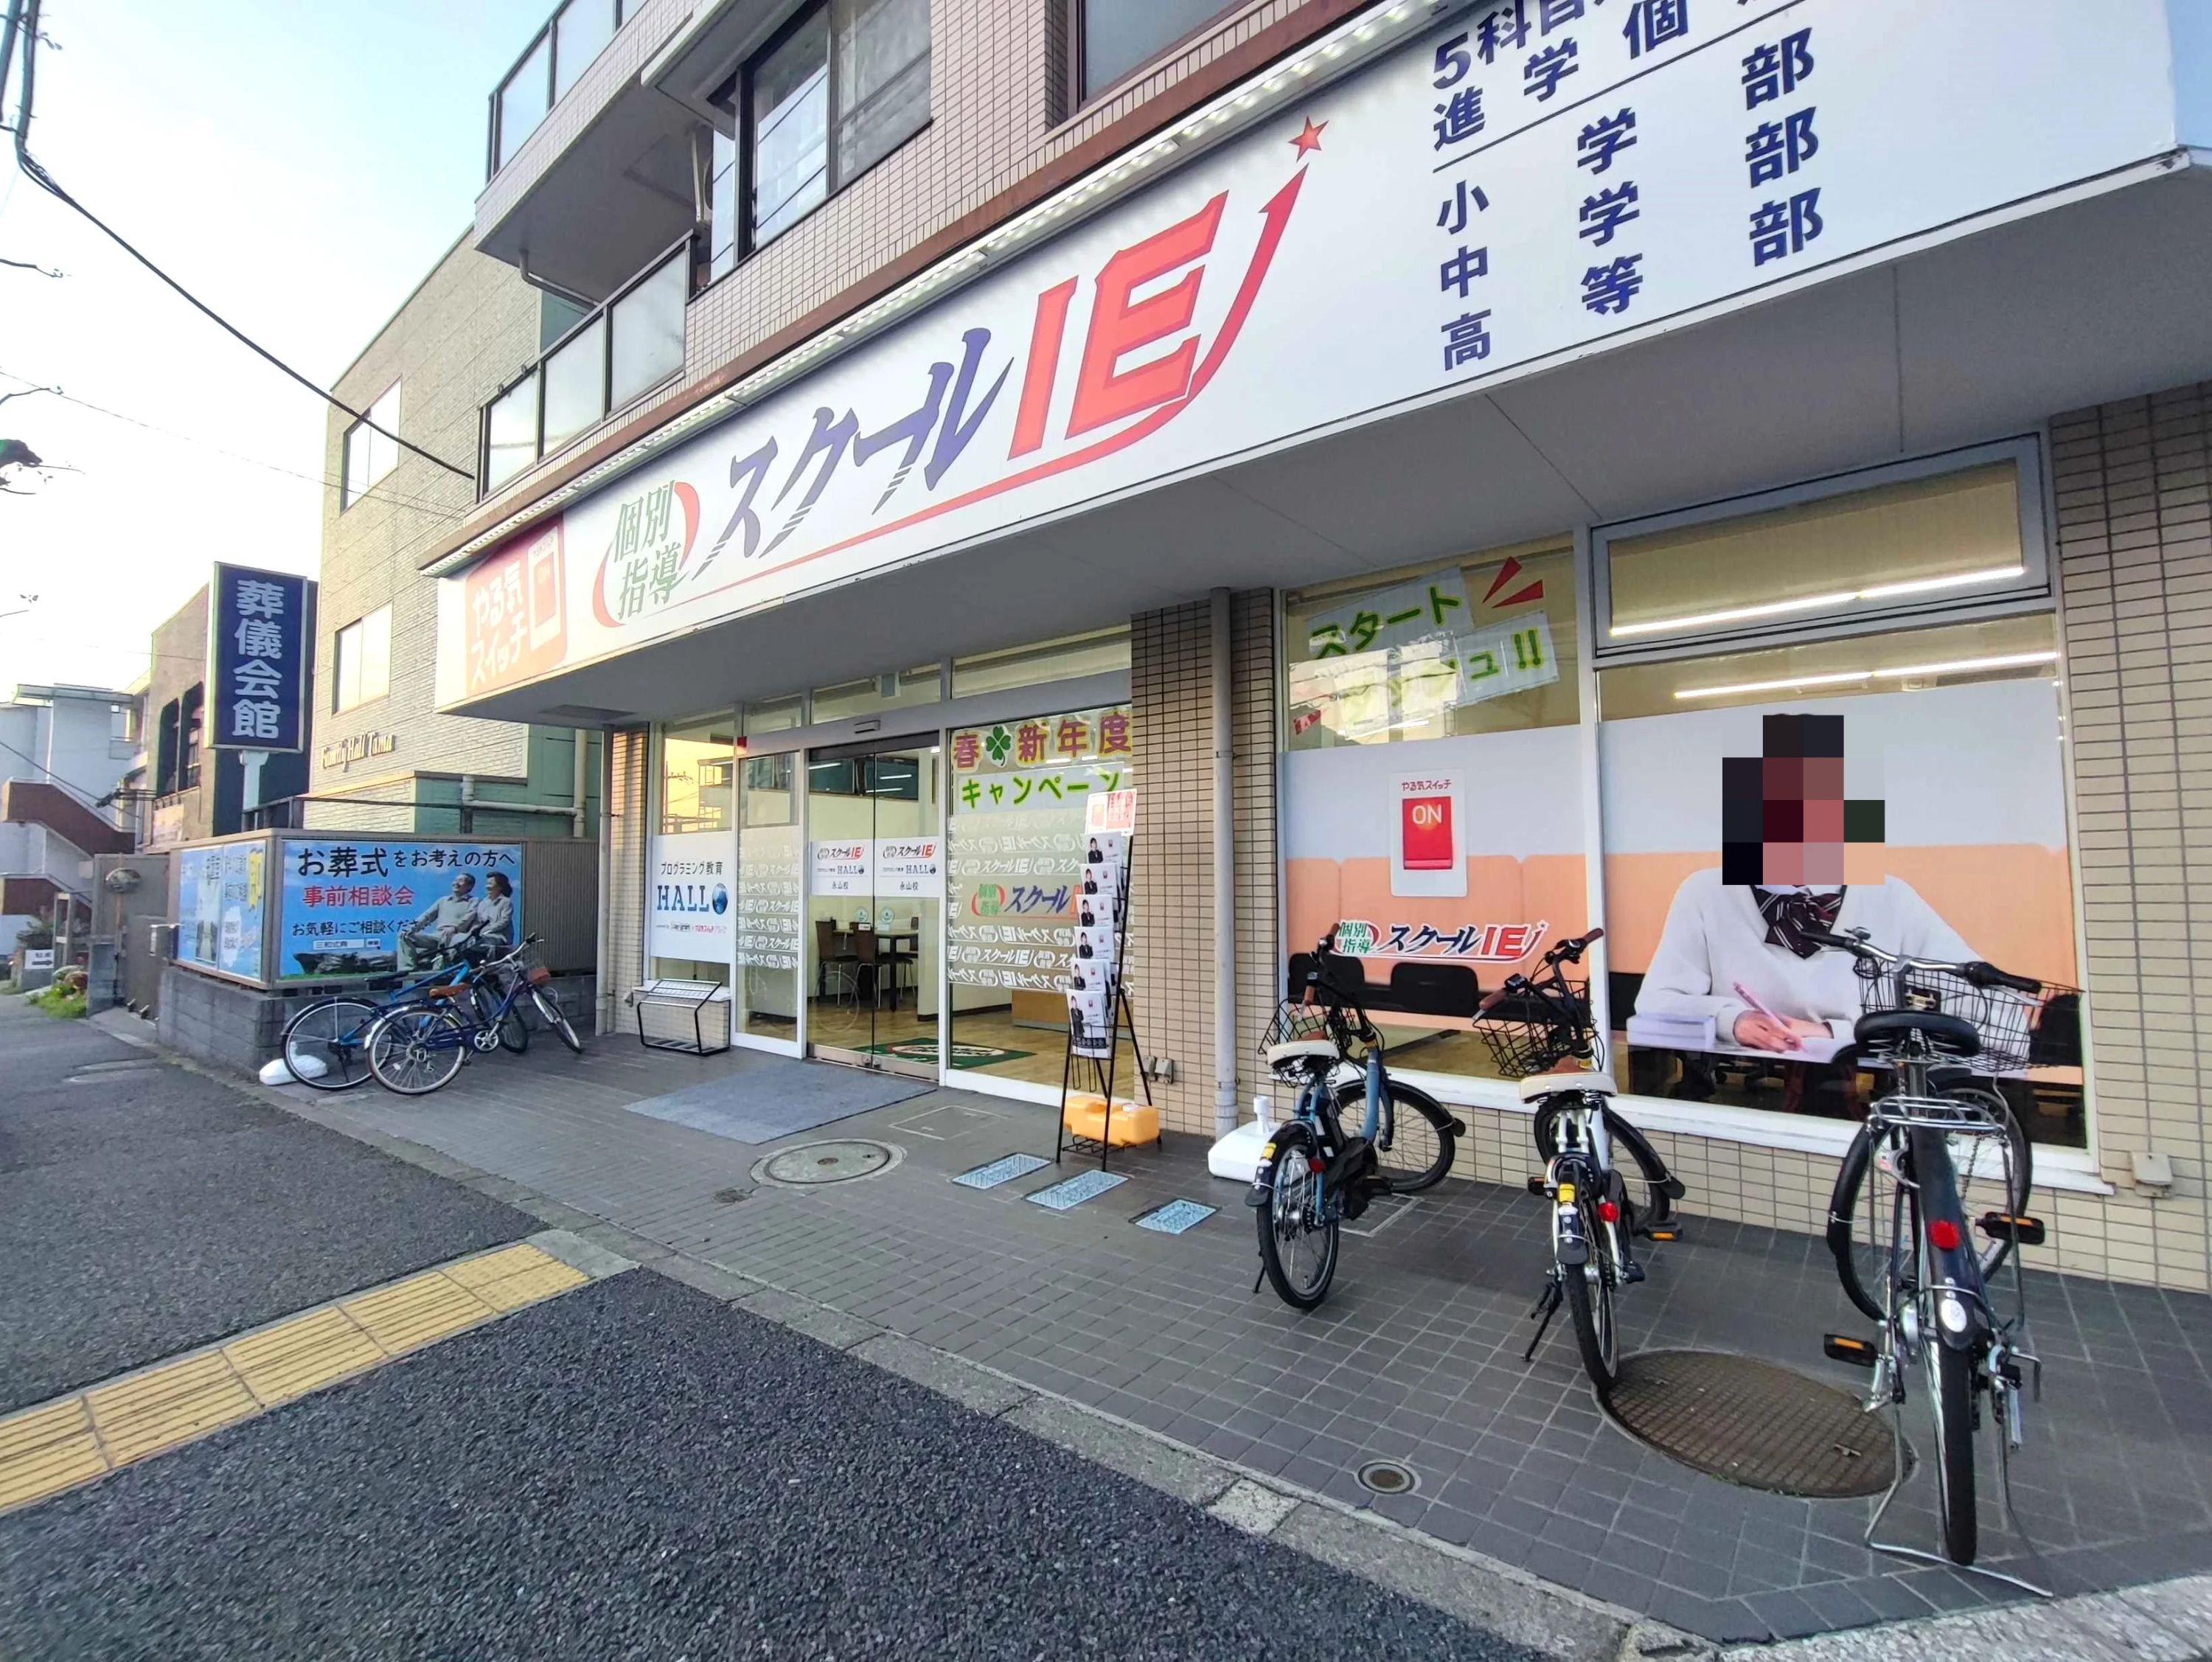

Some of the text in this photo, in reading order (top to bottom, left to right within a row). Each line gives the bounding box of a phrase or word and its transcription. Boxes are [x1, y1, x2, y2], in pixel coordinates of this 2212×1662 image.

[614, 480, 675, 563] 個別
[472, 560, 524, 639] やる気
[618, 542, 692, 621] 指導
[1312, 586, 1459, 659] スタート
[232, 579, 285, 739] 葬儀会館
[470, 611, 528, 692] スイッチ
[953, 712, 1133, 769] 春 新年度
[961, 771, 1120, 809] キャンペーン
[1402, 779, 1452, 792] やる気スイッチ
[1412, 804, 1442, 825] ON
[661, 860, 723, 875] プログラミング教育
[303, 885, 414, 908] 事前相談会
[1340, 922, 1367, 937] 個別
[1342, 937, 1371, 955] 指導
